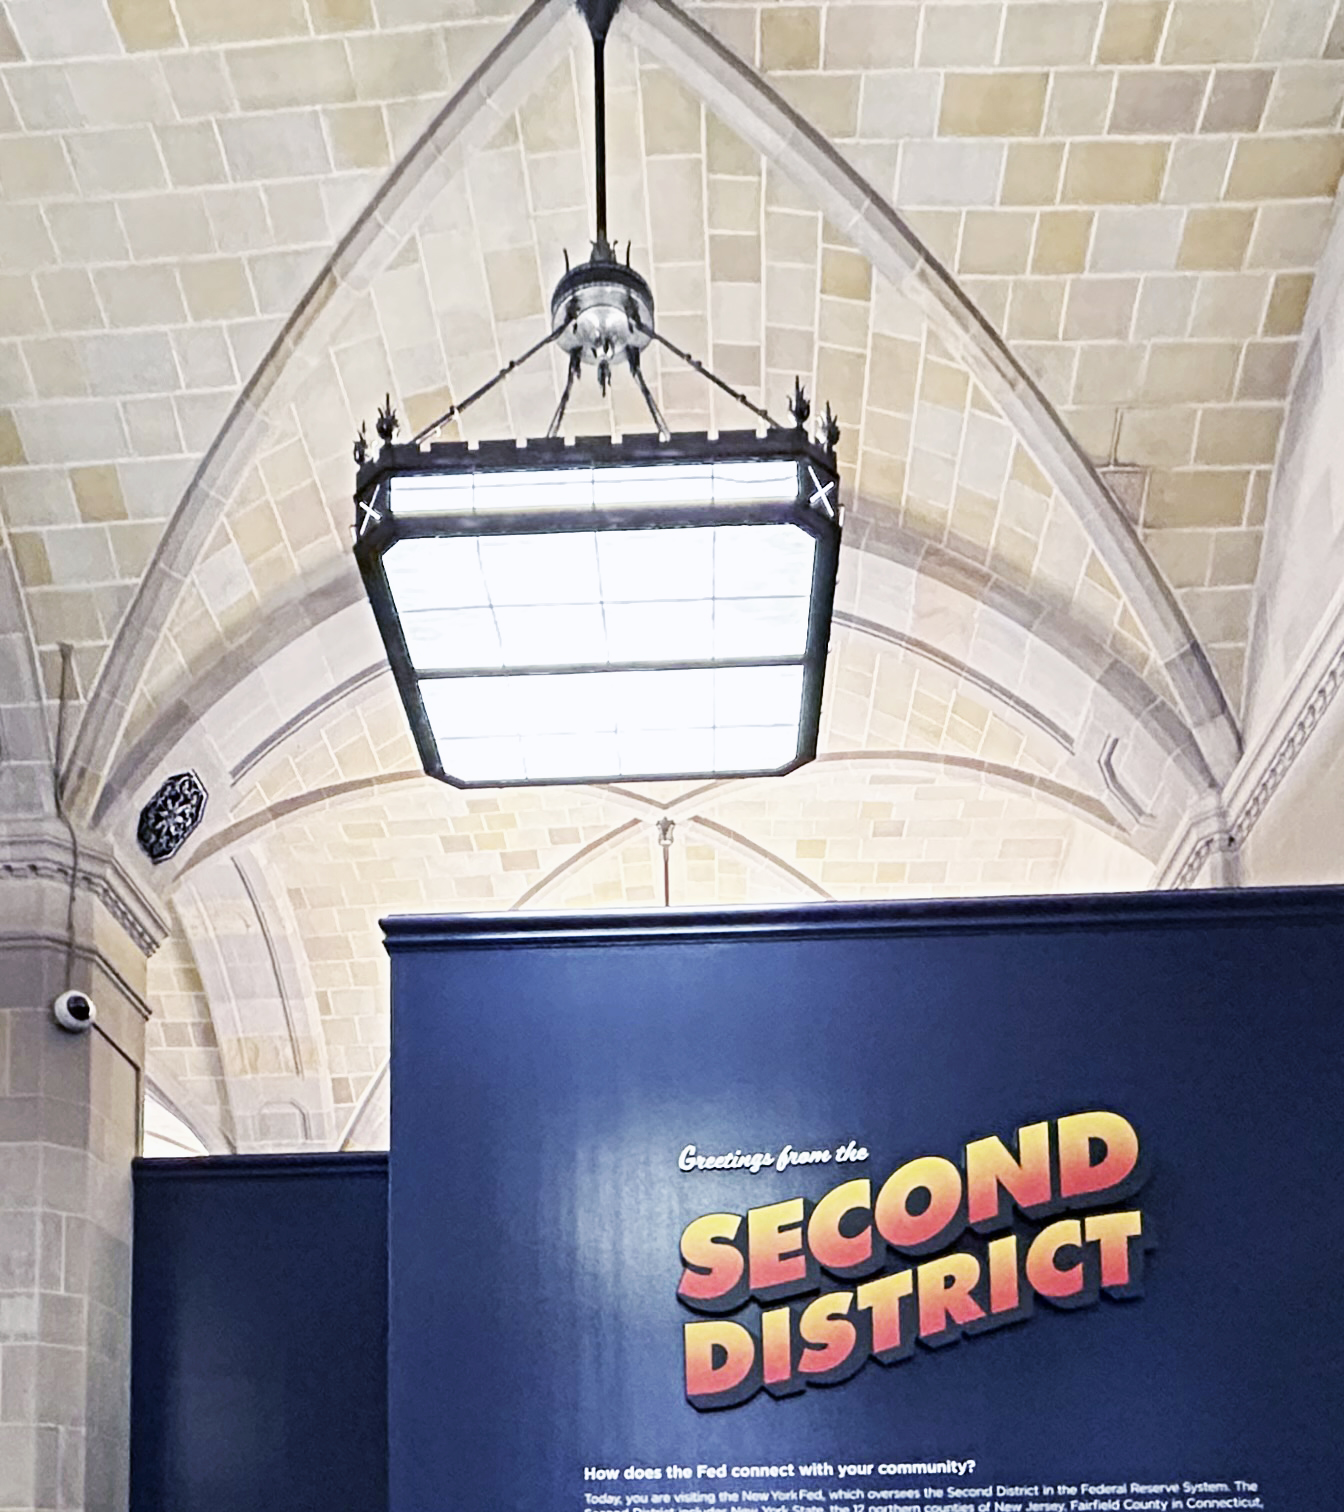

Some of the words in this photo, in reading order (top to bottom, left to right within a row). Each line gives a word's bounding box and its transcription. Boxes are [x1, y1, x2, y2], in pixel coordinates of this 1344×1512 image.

[678, 1143, 775, 1173] Greetings
[776, 1146, 832, 1170] from
[835, 1141, 869, 1163] the
[678, 1110, 1140, 1300] SECOND
[684, 1210, 1143, 1397] DISTRICT
[583, 1467, 621, 1480] How
[623, 1465, 663, 1480] does
[664, 1465, 694, 1479] the
[695, 1464, 728, 1478] Fed
[730, 1464, 796, 1479] connect
[797, 1462, 835, 1476] with
[836, 1464, 875, 1478] your
[876, 1459, 977, 1476] community?
[624, 1495, 650, 1506] you
[650, 1494, 672, 1504] are
[673, 1491, 716, 1505] visiting
[718, 1490, 740, 1502] the
[741, 1490, 771, 1502] New
[769, 1489, 799, 1501] York
[827, 1488, 866, 1500] which
[866, 1489, 922, 1499] oversees
[922, 1487, 945, 1499] the
[946, 1485, 994, 1498] Second
[995, 1485, 1041, 1497] District
[1041, 1485, 1056, 1496] in
[1056, 1485, 1079, 1496] the
[1079, 1483, 1128, 1495] Federal
[1129, 1482, 1182, 1494] Reserve
[1181, 1481, 1232, 1494] System.
[1233, 1480, 1259, 1492] The
[976, 1501, 992, 1512] of
[993, 1501, 1023, 1512] New
[1068, 1499, 1121, 1511] Fairfield
[1122, 1499, 1169, 1512] County
[1170, 1498, 1185, 1509] in
